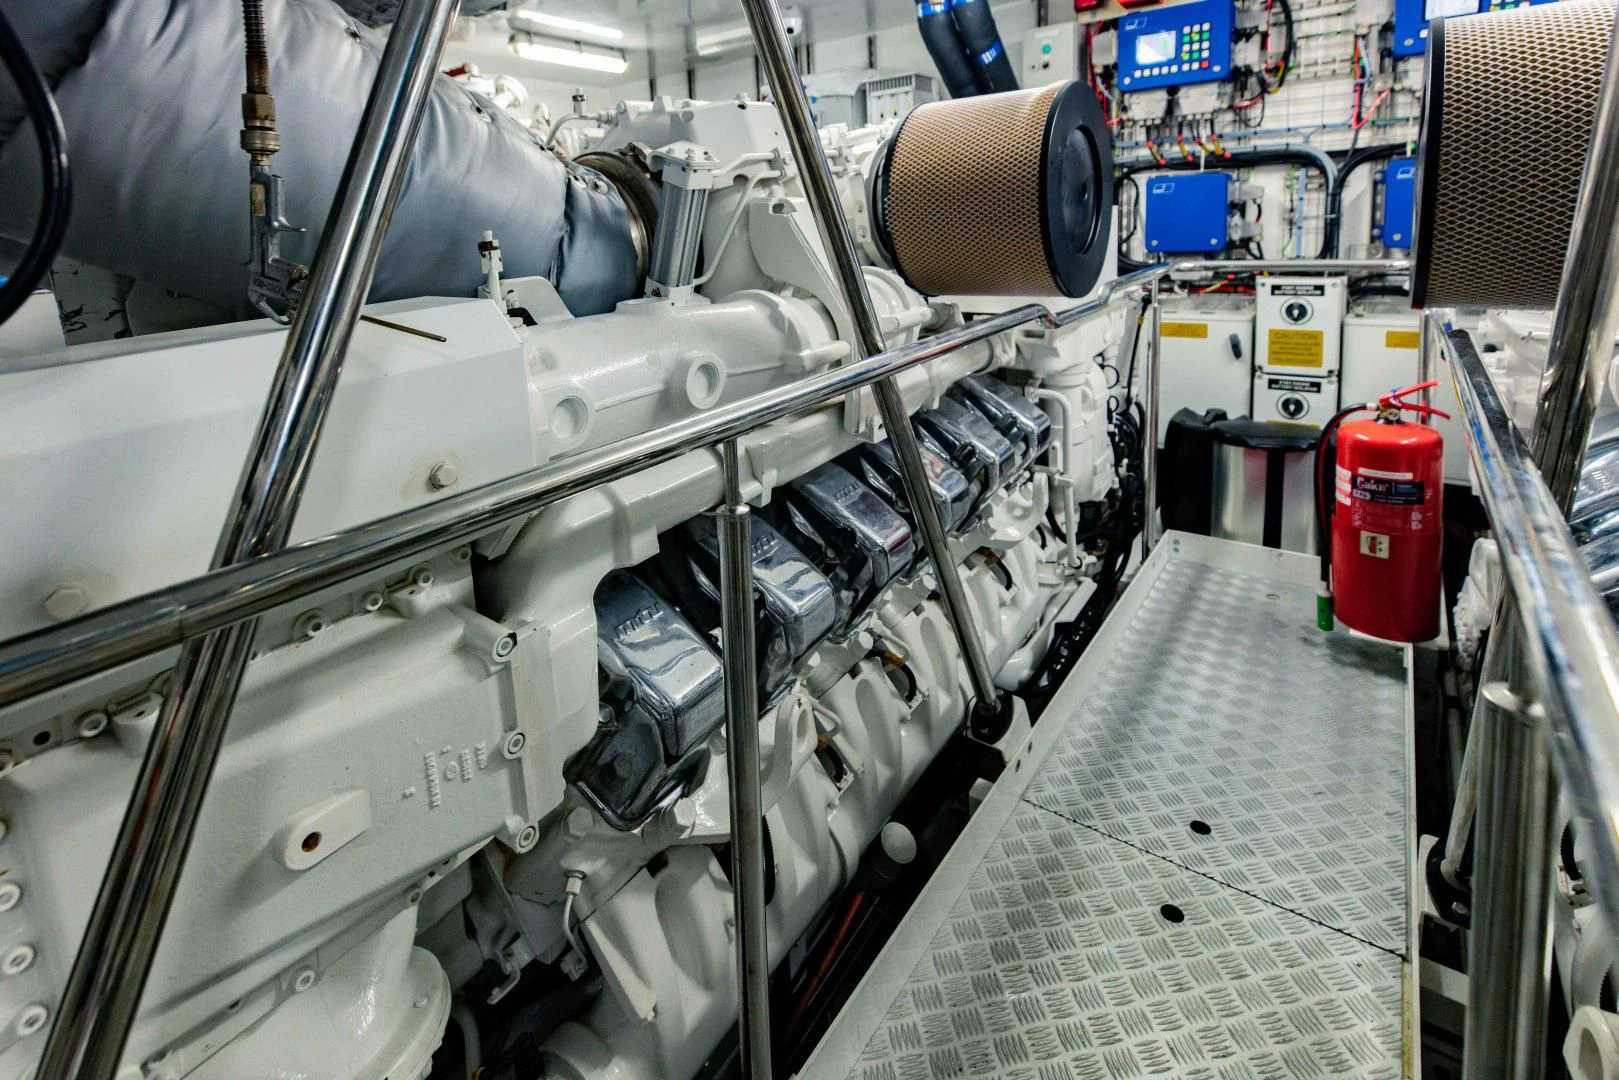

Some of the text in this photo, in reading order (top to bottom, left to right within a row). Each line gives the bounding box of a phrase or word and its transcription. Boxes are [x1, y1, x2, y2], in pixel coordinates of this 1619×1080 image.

[1274, 332, 1319, 341] CAUTION
[835, 479, 861, 501] mtu
[613, 602, 662, 634] mtu
